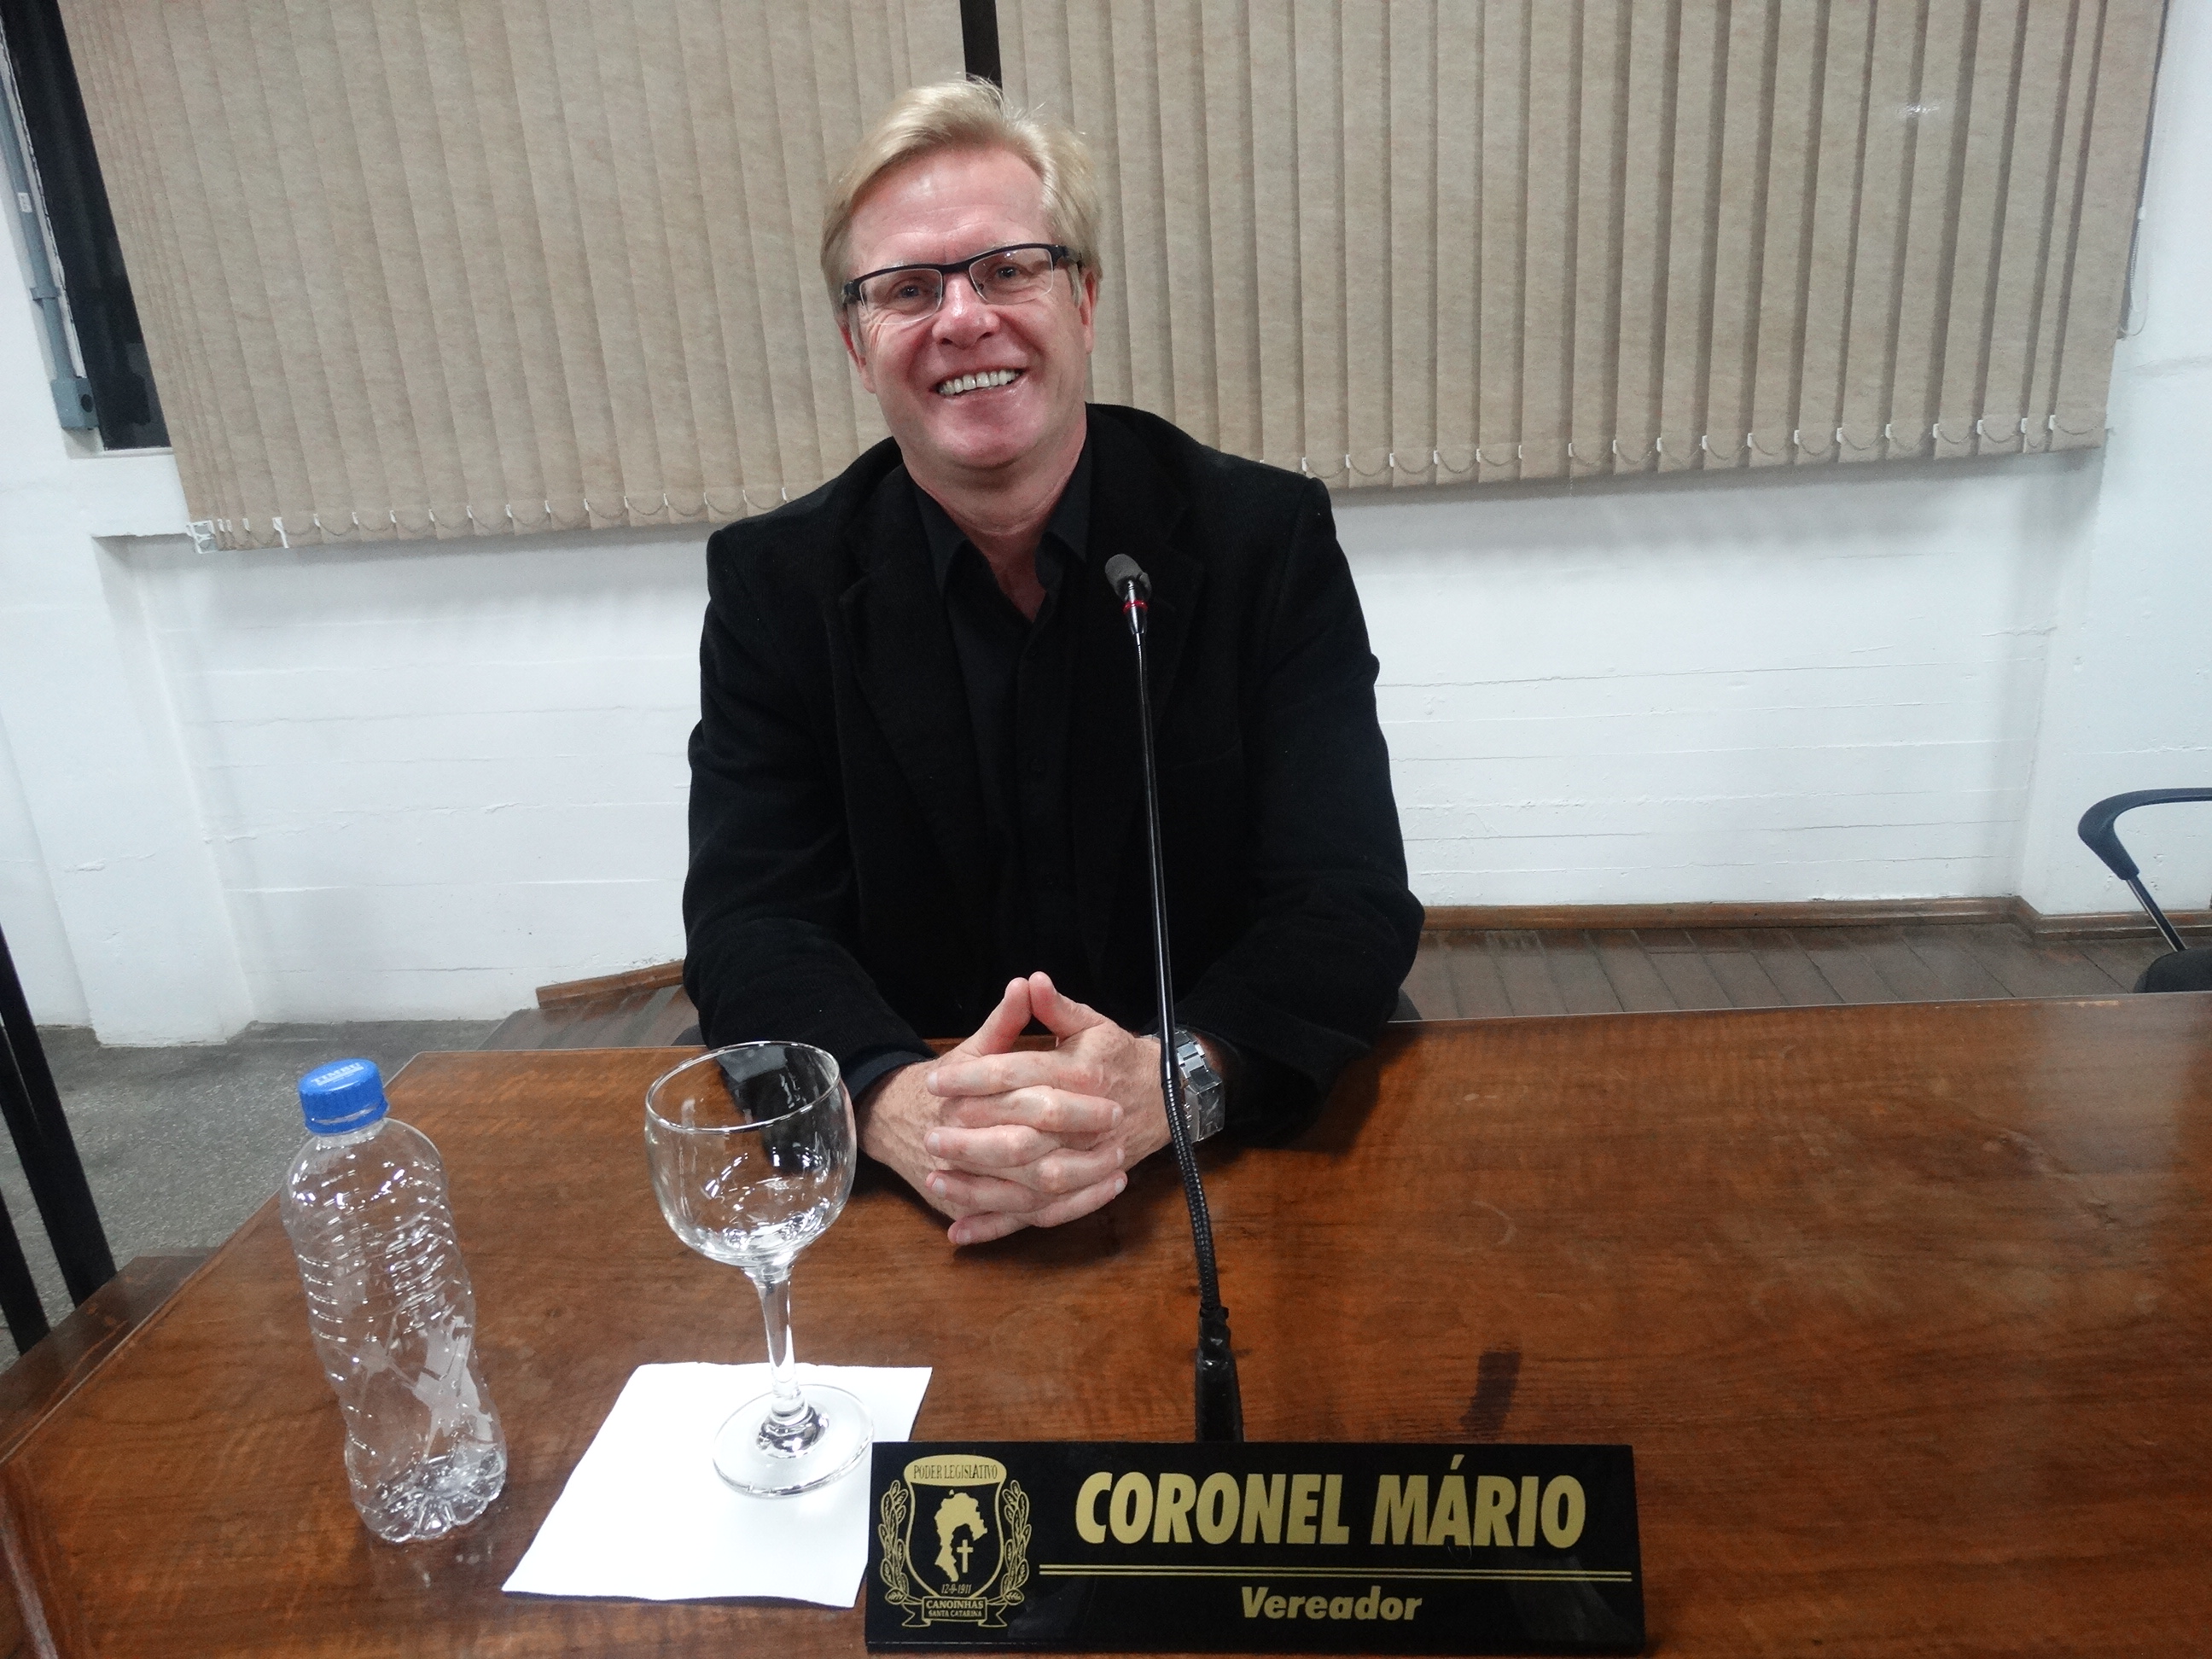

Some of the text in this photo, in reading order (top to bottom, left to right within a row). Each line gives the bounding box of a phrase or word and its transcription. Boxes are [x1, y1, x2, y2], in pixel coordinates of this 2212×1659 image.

[913, 1464, 998, 1479] PODER LEGISLATIVO
[1075, 1454, 1585, 1547] CORONEL MÁRIO
[926, 1600, 984, 1610] CANOINHAS
[1243, 1586, 1422, 1620] Vereador
